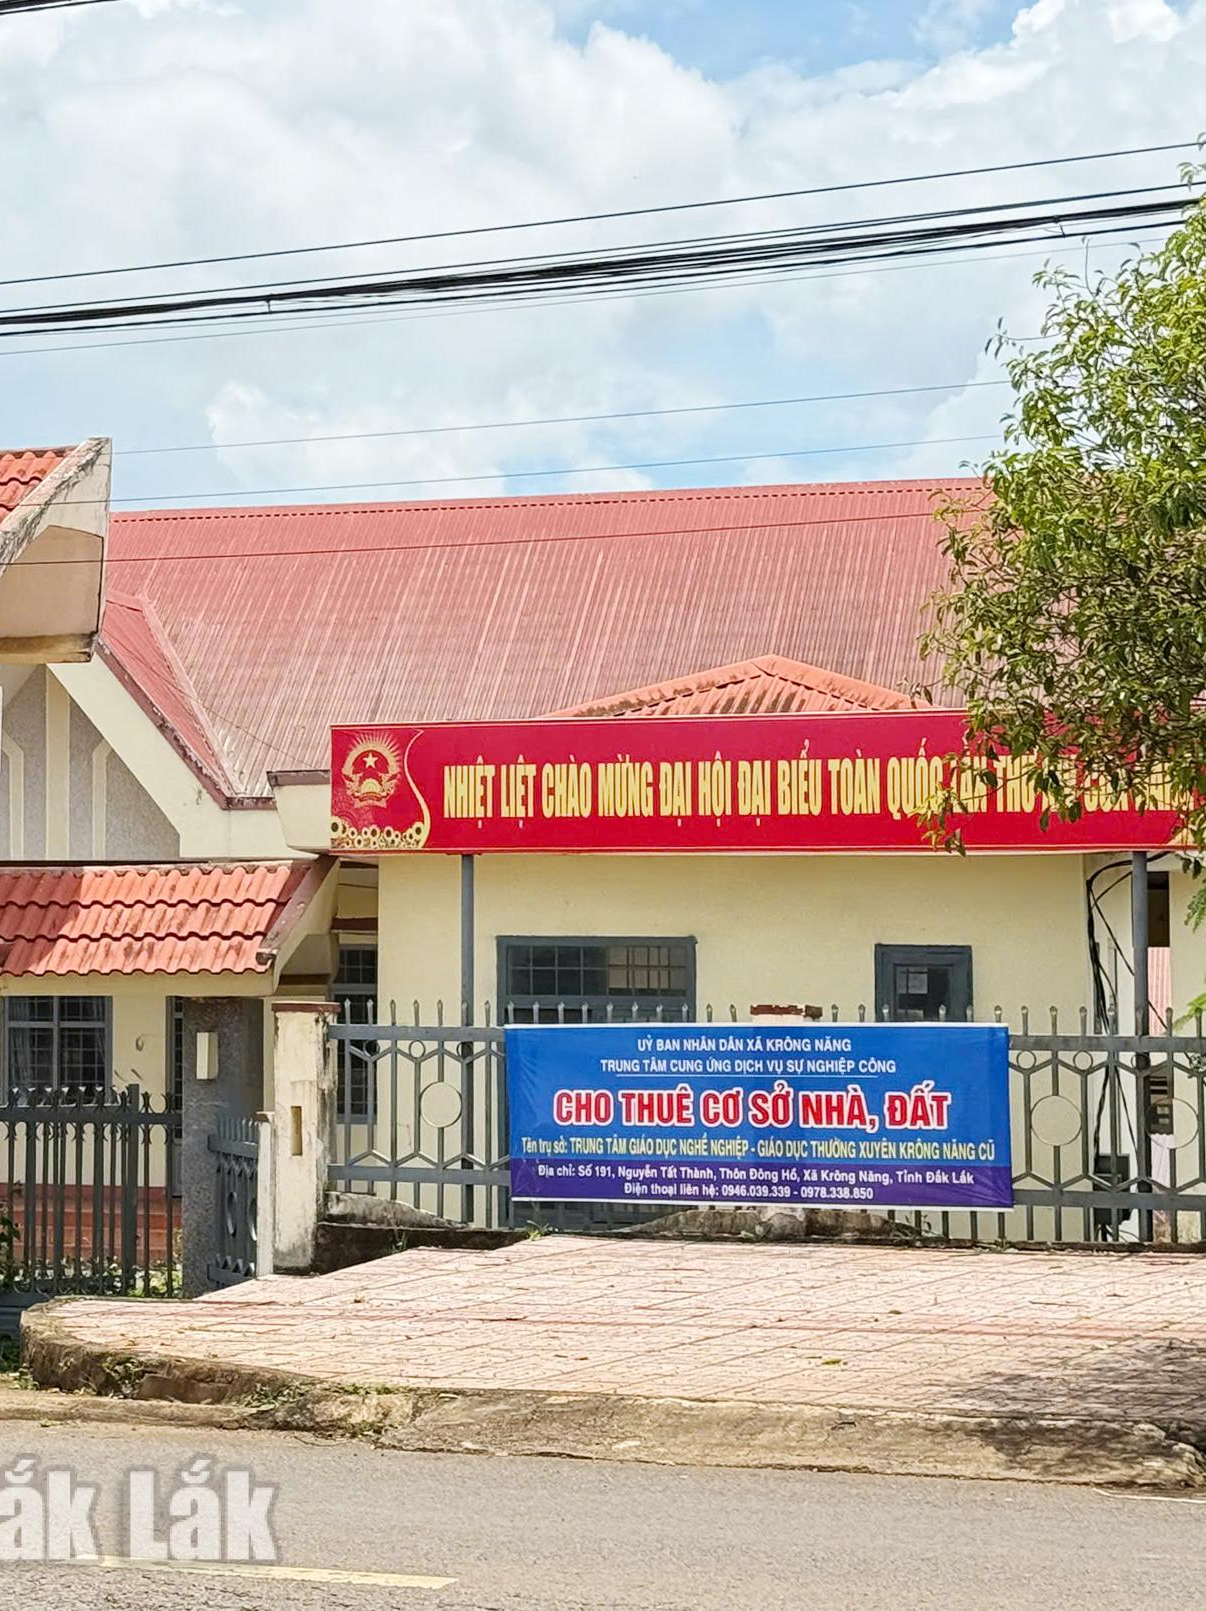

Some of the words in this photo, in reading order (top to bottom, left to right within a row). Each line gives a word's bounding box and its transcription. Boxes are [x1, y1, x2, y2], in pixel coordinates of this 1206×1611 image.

[444, 754, 495, 829] NHIỆT
[500, 754, 536, 829] LIỆT
[542, 754, 592, 818] CHÀO
[598, 753, 654, 817] MỪNG
[659, 761, 692, 827] ĐẠI
[698, 750, 731, 827] HỘI
[738, 760, 771, 826] ĐẠI
[777, 738, 822, 816] BIỂU
[828, 748, 880, 815] TOÀN
[887, 737, 944, 820] QUỐC
[656, 1038, 680, 1051] BAN
[683, 1036, 715, 1051] NHÂN
[719, 1036, 743, 1051] DÂN
[746, 1036, 763, 1051] XÃ
[766, 1036, 811, 1051] KRÔNG
[815, 1036, 851, 1051] NĂNG
[600, 1059, 640, 1072] TRUNG
[643, 1057, 666, 1072] TÂM
[670, 1059, 703, 1072] CUNG
[706, 1056, 731, 1072] ỨNG
[734, 1059, 763, 1075] DỊCH
[766, 1059, 783, 1075] VỤ
[787, 1058, 804, 1075] SỰ
[807, 1056, 855, 1075] NGHIỆP
[858, 1057, 896, 1073] CÔNG
[554, 1090, 612, 1126] CHO
[620, 1085, 693, 1127] THUÊ
[699, 1088, 743, 1127] CƠ
[749, 1080, 795, 1128] SỞ
[800, 1085, 878, 1133] NHÀ,
[885, 1079, 951, 1130] ĐẤT
[521, 1136, 537, 1154] Tên
[538, 1138, 552, 1160] trụ
[553, 1135, 568, 1154] sở:
[570, 1137, 603, 1155] TRUNG
[606, 1134, 626, 1155] TÂM
[629, 1133, 653, 1156] GIÁO
[656, 1139, 676, 1160] DỤC
[710, 1135, 749, 1160] NGHIỆP
[757, 1136, 784, 1157] GIÁO
[786, 1140, 808, 1161] DỤC
[810, 1136, 856, 1159] THƯỜNG
[859, 1138, 895, 1159] XUYÊN
[900, 1138, 940, 1160] KRÔNG
[943, 1138, 976, 1161] NĂNG
[978, 1139, 995, 1161] CŨ
[538, 1165, 554, 1178] Địa
[557, 1163, 576, 1177] chỉ:
[578, 1164, 593, 1177] Số
[595, 1165, 616, 1179] 191,
[618, 1164, 658, 1181] Nguyễn
[660, 1164, 677, 1178] Tất
[680, 1166, 717, 1181] Thành,
[719, 1167, 746, 1179] Thôn
[803, 1168, 818, 1181] Xã
[821, 1169, 856, 1184] Krông
[859, 1171, 893, 1185] Năng,
[896, 1169, 922, 1183] Tỉnh
[624, 1183, 648, 1198] Điện
[650, 1183, 677, 1198] thoại
[679, 1184, 699, 1196] liên
[702, 1184, 719, 1199] hệ:
[721, 1185, 791, 1198] 0946.039.339
[801, 1186, 874, 1199] 0978.338.850
